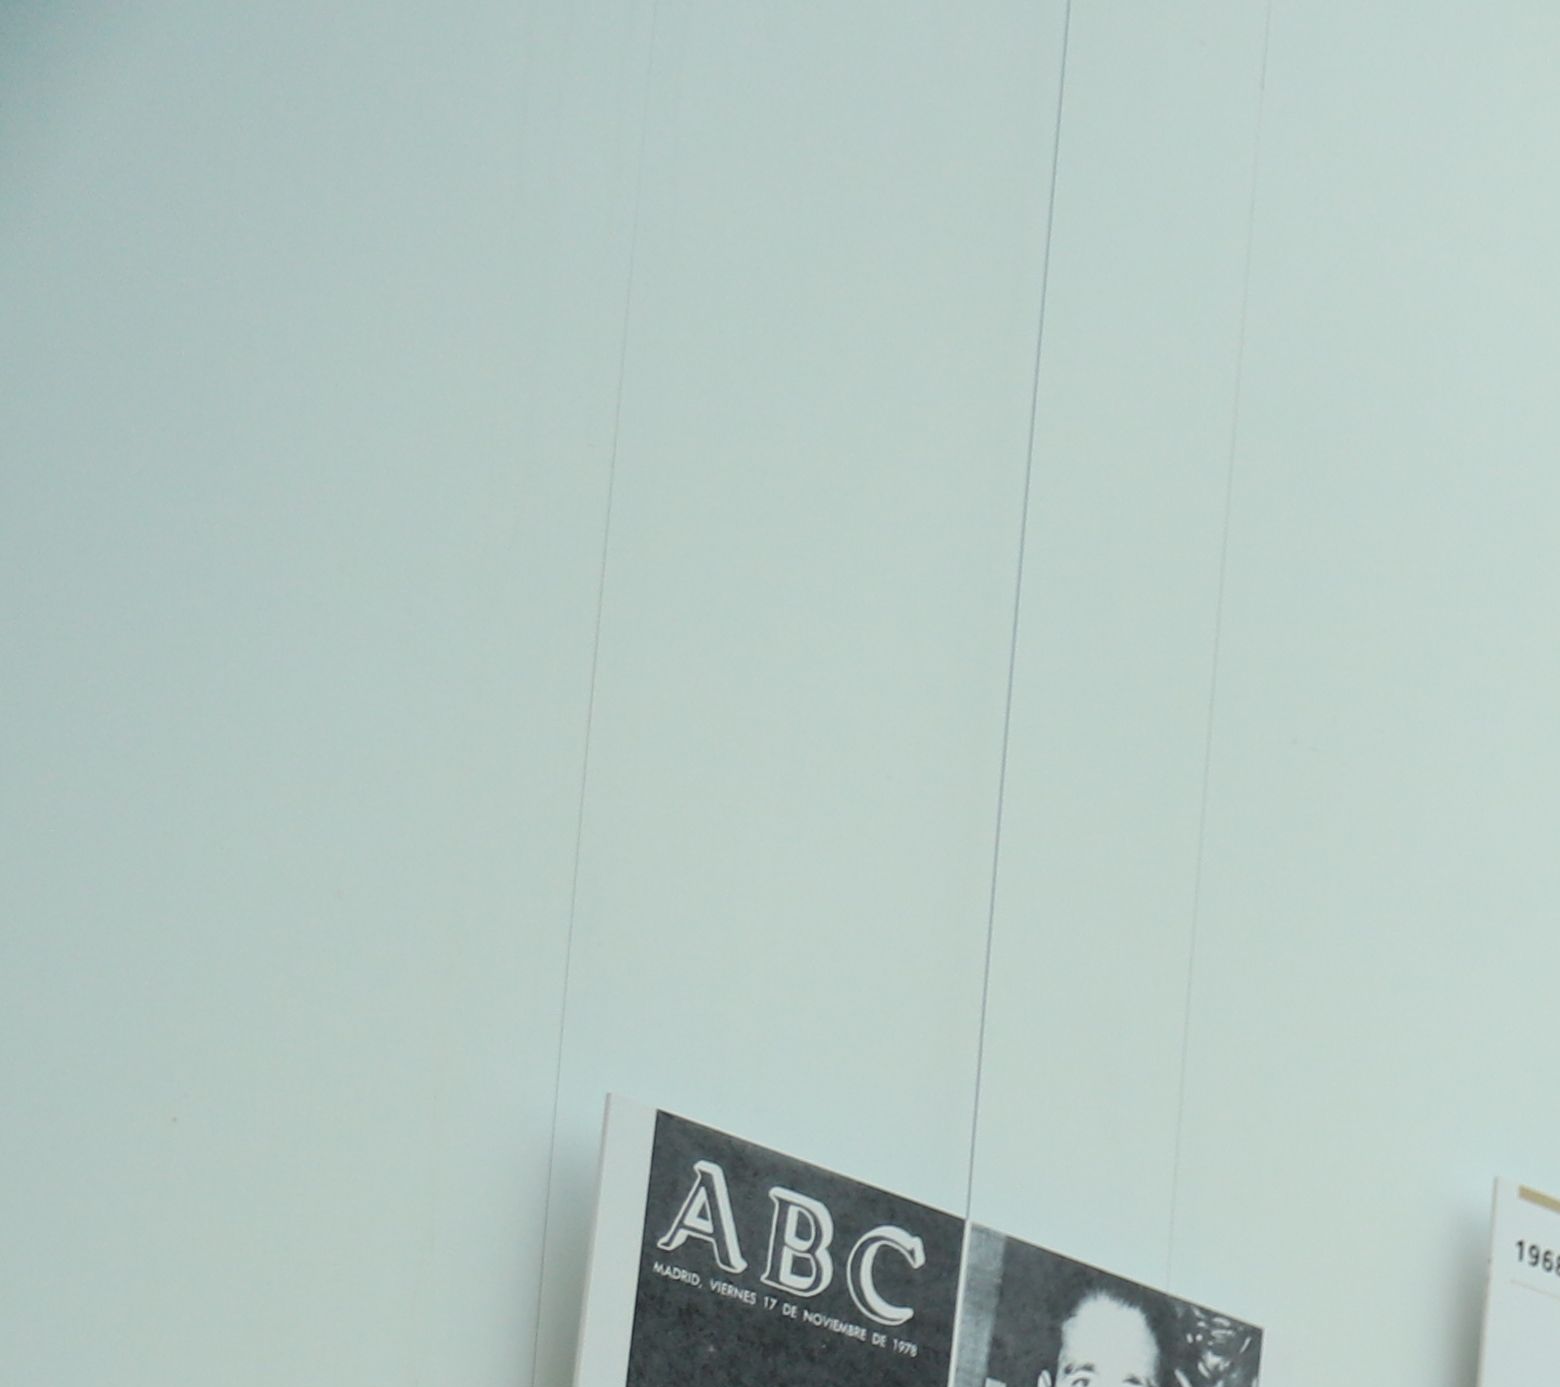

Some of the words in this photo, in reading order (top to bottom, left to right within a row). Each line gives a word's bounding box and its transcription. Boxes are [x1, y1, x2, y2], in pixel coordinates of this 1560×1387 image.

[657, 1160, 925, 1325] ABC
[653, 1261, 701, 1288] MADRID,
[709, 1279, 756, 1304] VIERNES
[764, 1296, 777, 1309] 17
[782, 1302, 797, 1318] DE
[803, 1309, 866, 1340] NOVIEMBRE
[871, 1332, 886, 1347] DE
[893, 1338, 917, 1356] 1978
